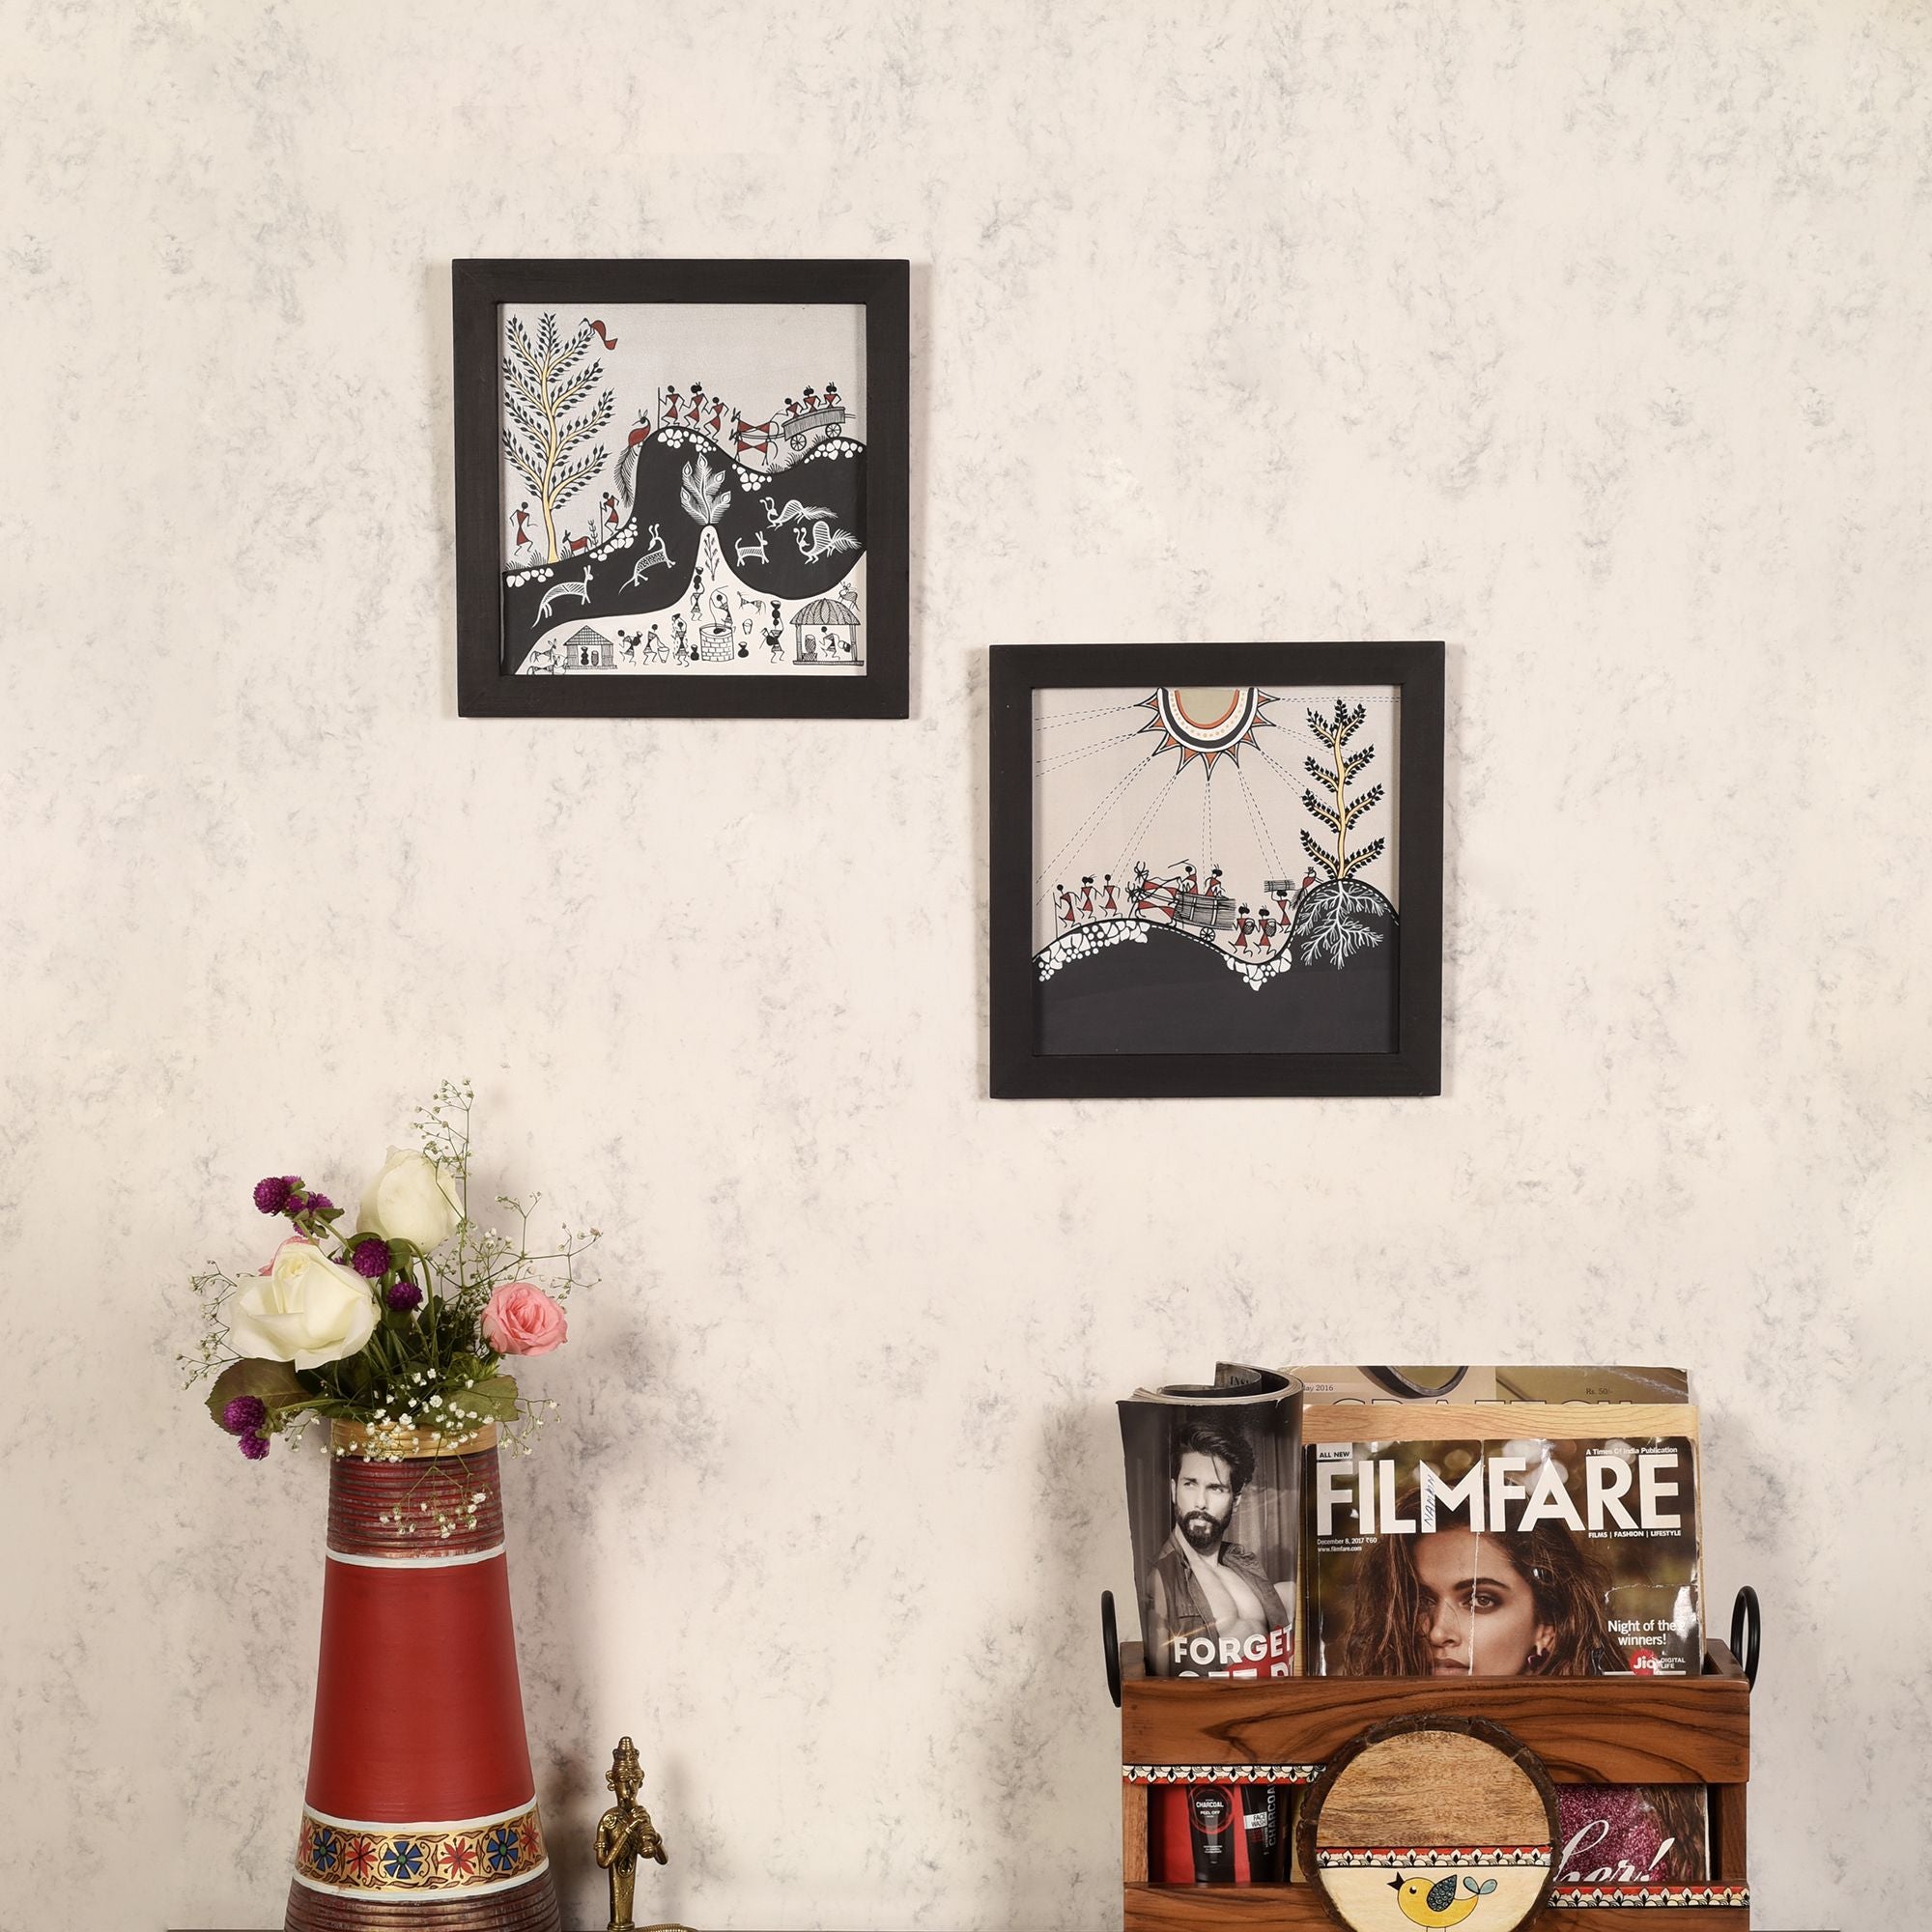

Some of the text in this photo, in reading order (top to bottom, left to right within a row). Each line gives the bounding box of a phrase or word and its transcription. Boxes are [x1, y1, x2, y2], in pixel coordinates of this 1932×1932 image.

[1317, 1454, 1681, 1536] FILMFARE
[1607, 1620, 1640, 1634] Night
[1642, 1619, 1656, 1632] of
[1174, 1623, 1293, 1665] FORGET
[1617, 1634, 1666, 1646] winners!
[1633, 1656, 1657, 1669] Jio
[1266, 1784, 1276, 1847] CHARCOA
[1251, 1819, 1266, 1828] WASH
